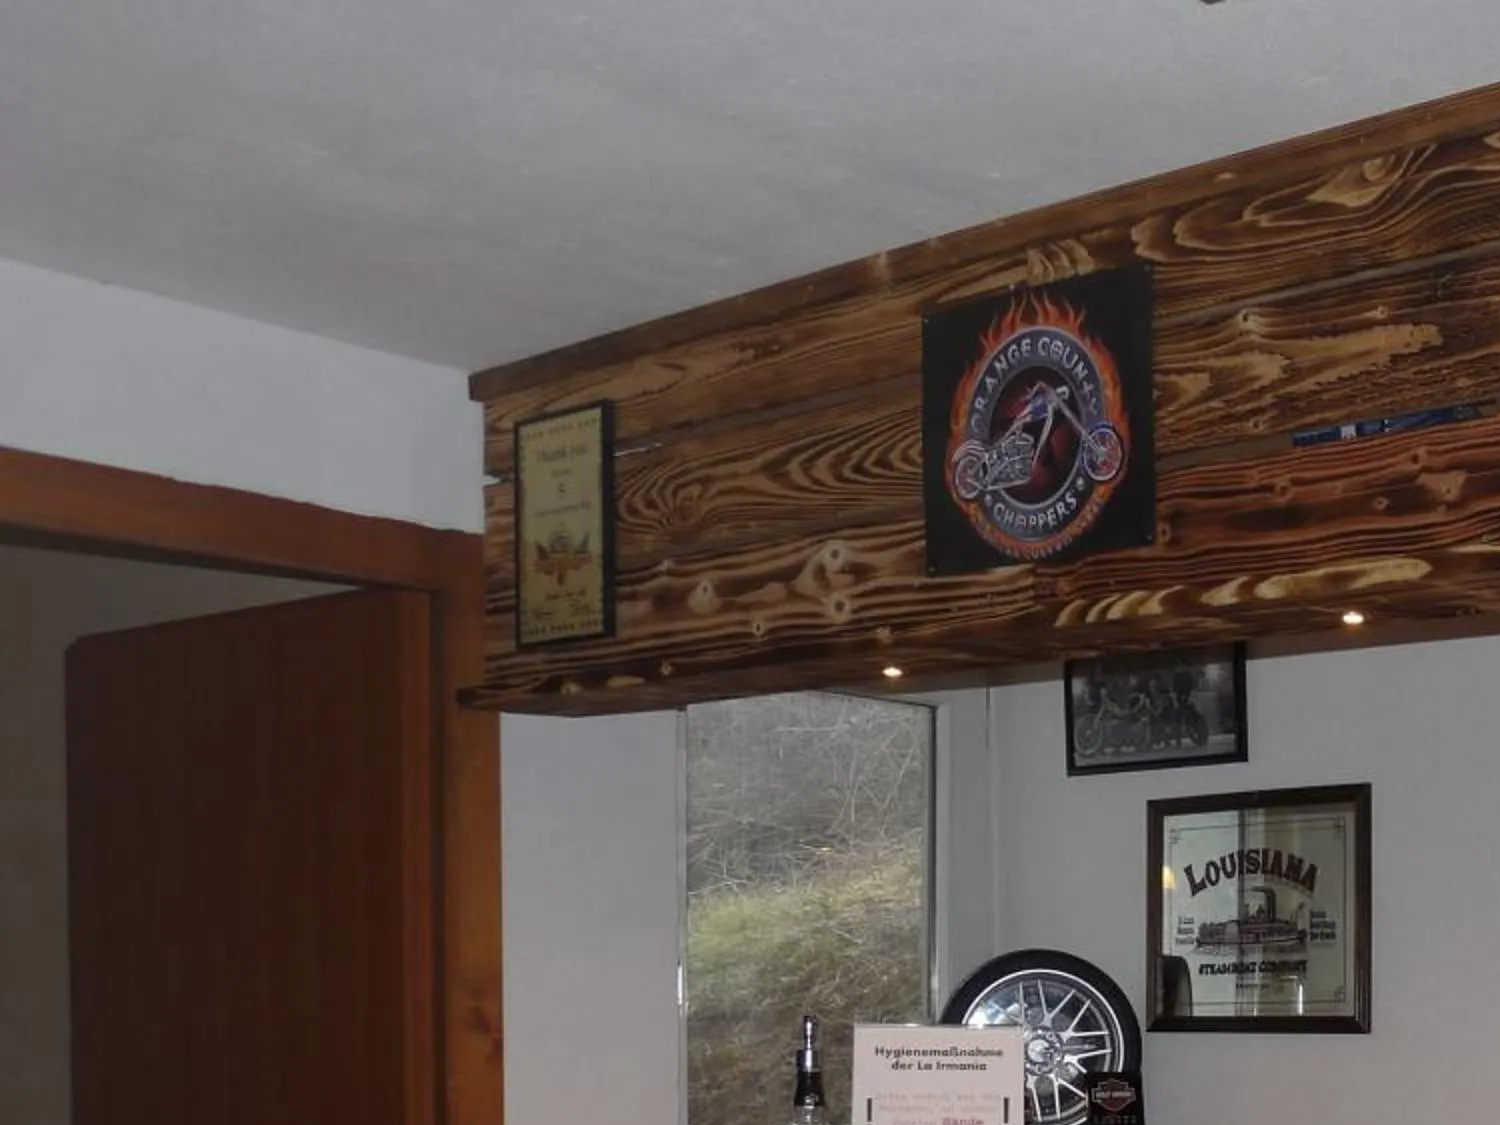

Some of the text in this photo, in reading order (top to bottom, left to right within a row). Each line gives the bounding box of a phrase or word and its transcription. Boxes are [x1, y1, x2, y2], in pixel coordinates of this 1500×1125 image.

[971, 336, 1100, 434] ORANGE COUNTY
[993, 493, 1078, 530] CHOPPERS
[1184, 847, 1318, 898] LOUISIANA
[874, 1045, 1005, 1059] Hygienemaßnahme
[890, 1060, 988, 1071] der La Irmania
